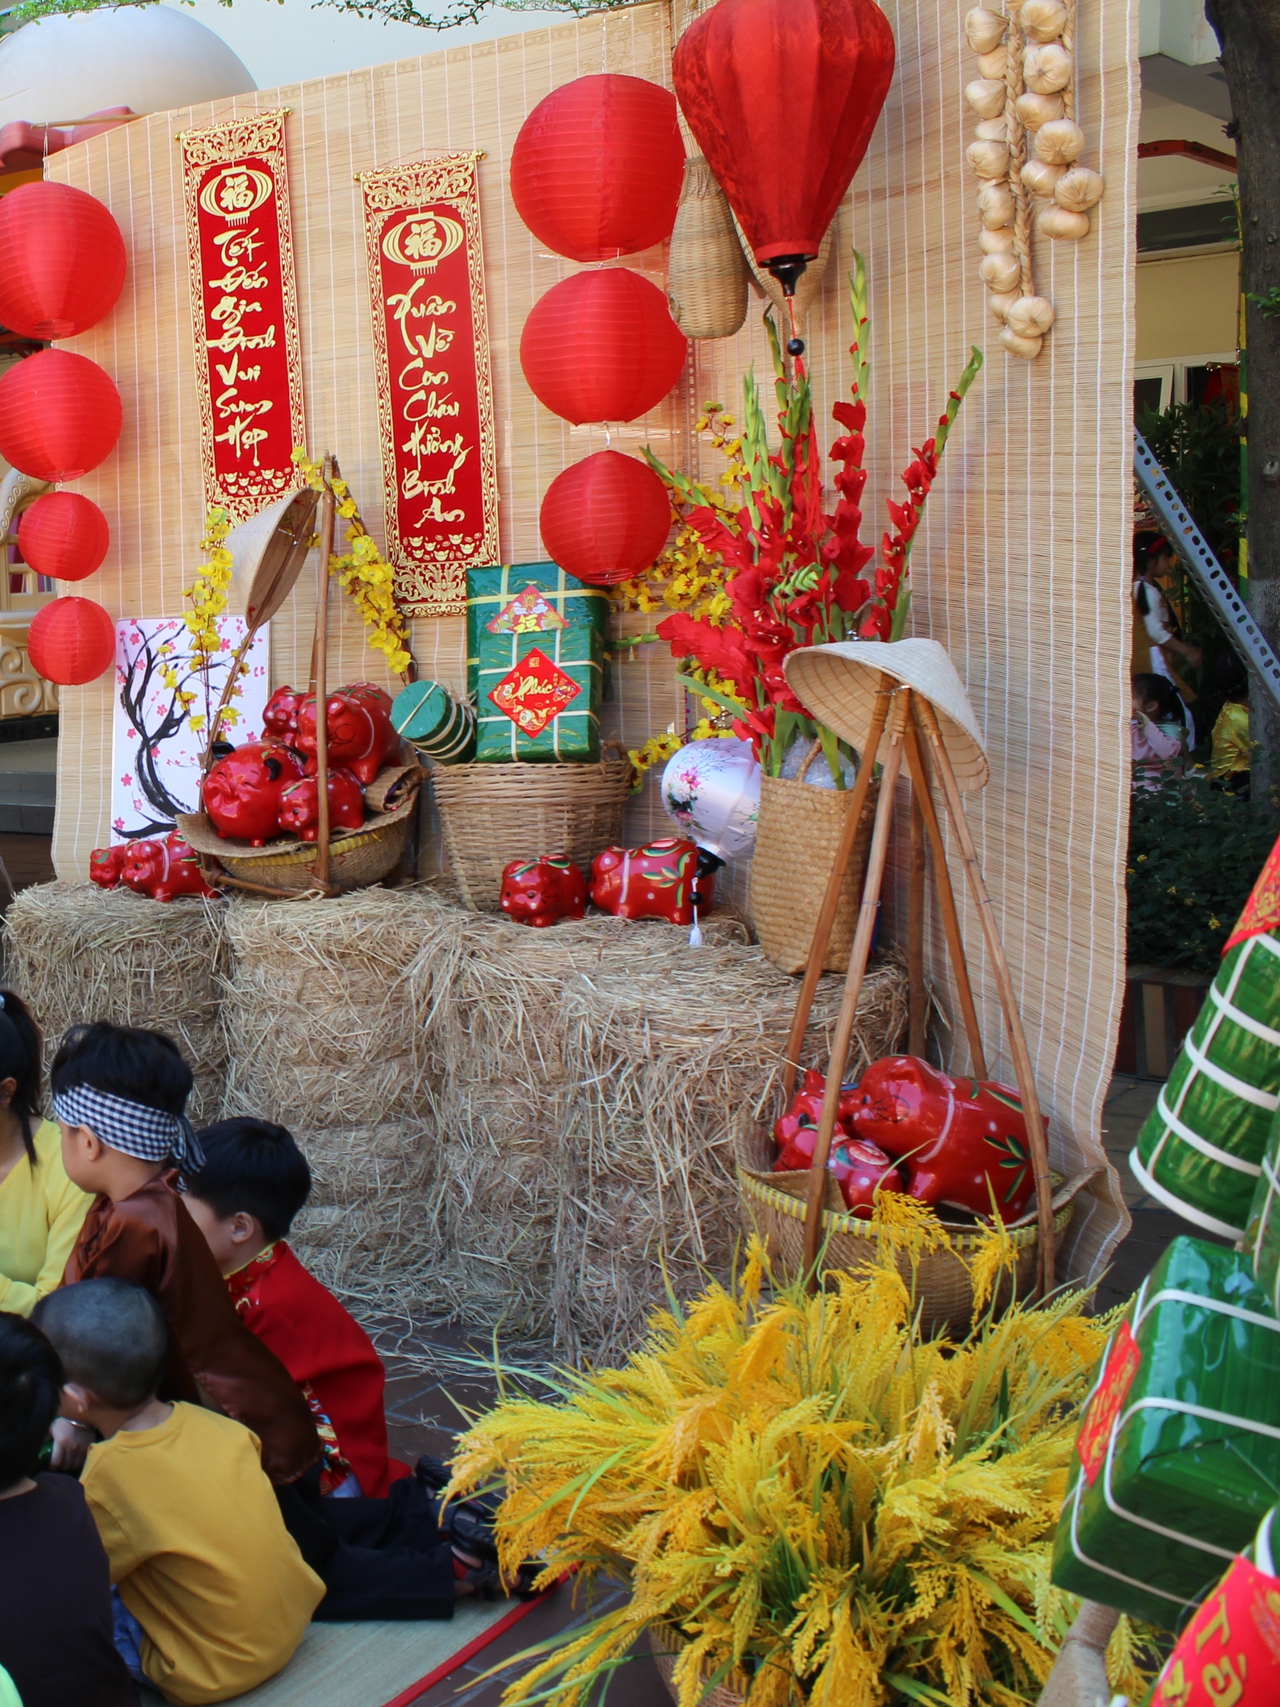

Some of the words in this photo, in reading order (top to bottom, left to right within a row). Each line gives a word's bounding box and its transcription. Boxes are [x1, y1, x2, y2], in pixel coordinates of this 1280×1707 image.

[220, 174, 254, 211] 福
[213, 227, 265, 267] Tết
[404, 220, 442, 260] 福
[208, 261, 268, 293] Đến
[211, 296, 262, 330] Gia
[387, 278, 457, 356] Xuân
[206, 325, 276, 353] Đình
[415, 320, 456, 358] Về
[215, 351, 261, 386] Vui
[399, 357, 449, 391] Con
[216, 387, 273, 419] Sum
[403, 390, 460, 421] Cháu
[215, 413, 269, 467] Họp
[402, 419, 474, 471] Hưởng
[402, 467, 456, 499] Bình
[413, 496, 465, 528] An
[513, 675, 555, 701] Phúc
